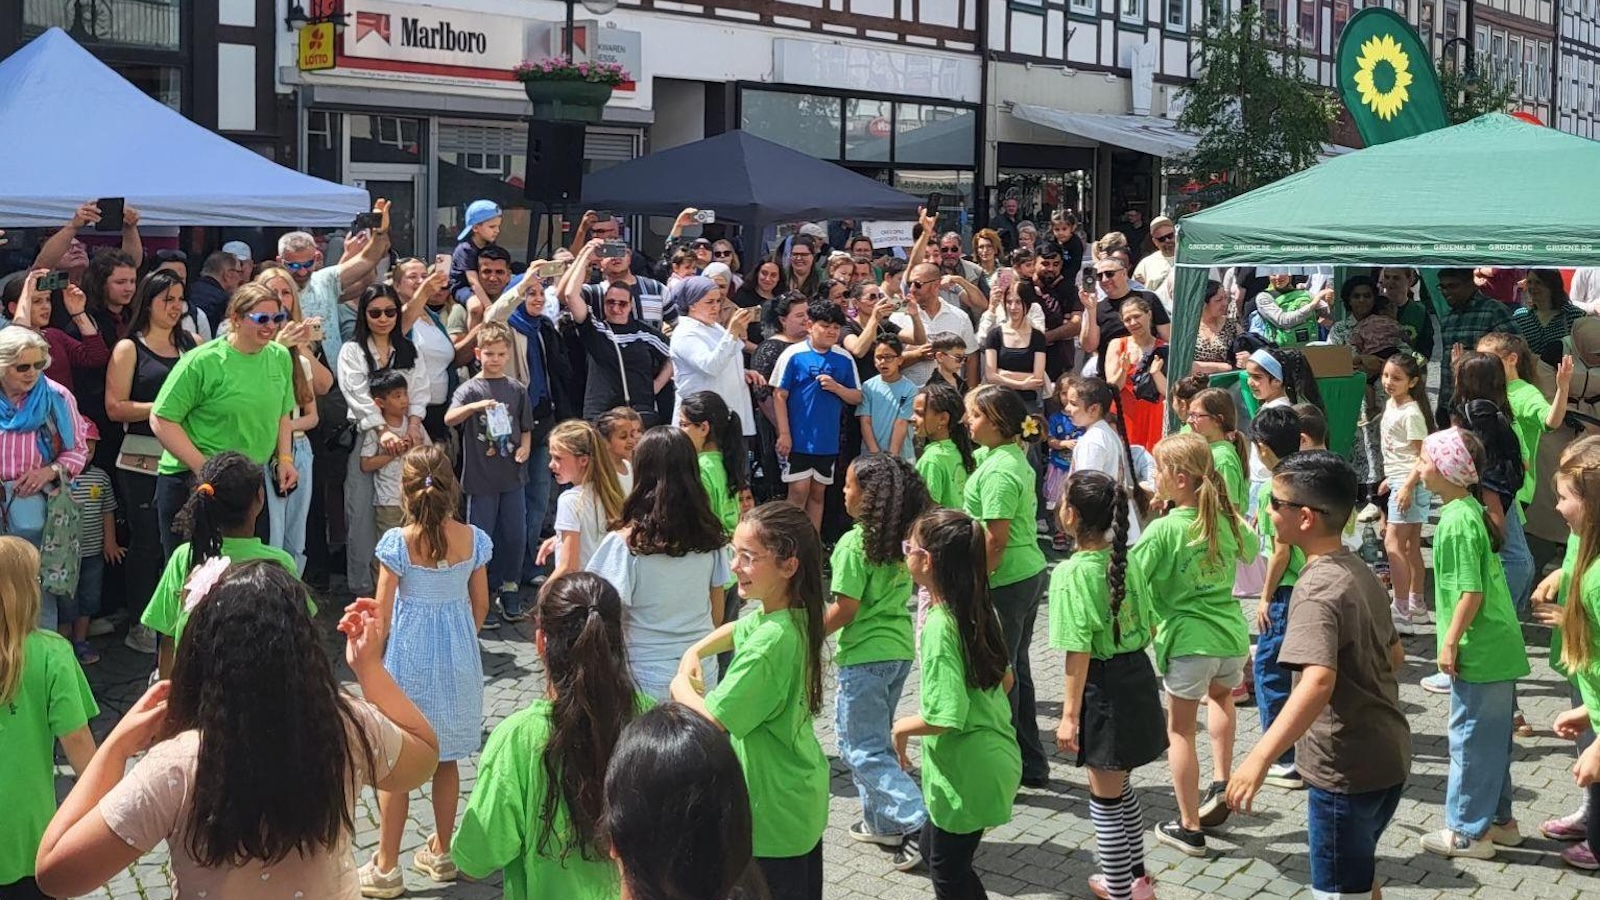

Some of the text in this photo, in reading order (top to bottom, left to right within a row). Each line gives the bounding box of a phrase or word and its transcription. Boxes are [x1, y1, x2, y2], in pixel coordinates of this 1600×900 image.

[401, 17, 487, 54] Marlboro
[304, 54, 329, 66] LOTTO
[1433, 244, 1477, 252] GRUENE.DE
[1488, 244, 1533, 252] GRUENE.DE
[1545, 244, 1593, 252] GRUENE.DE
